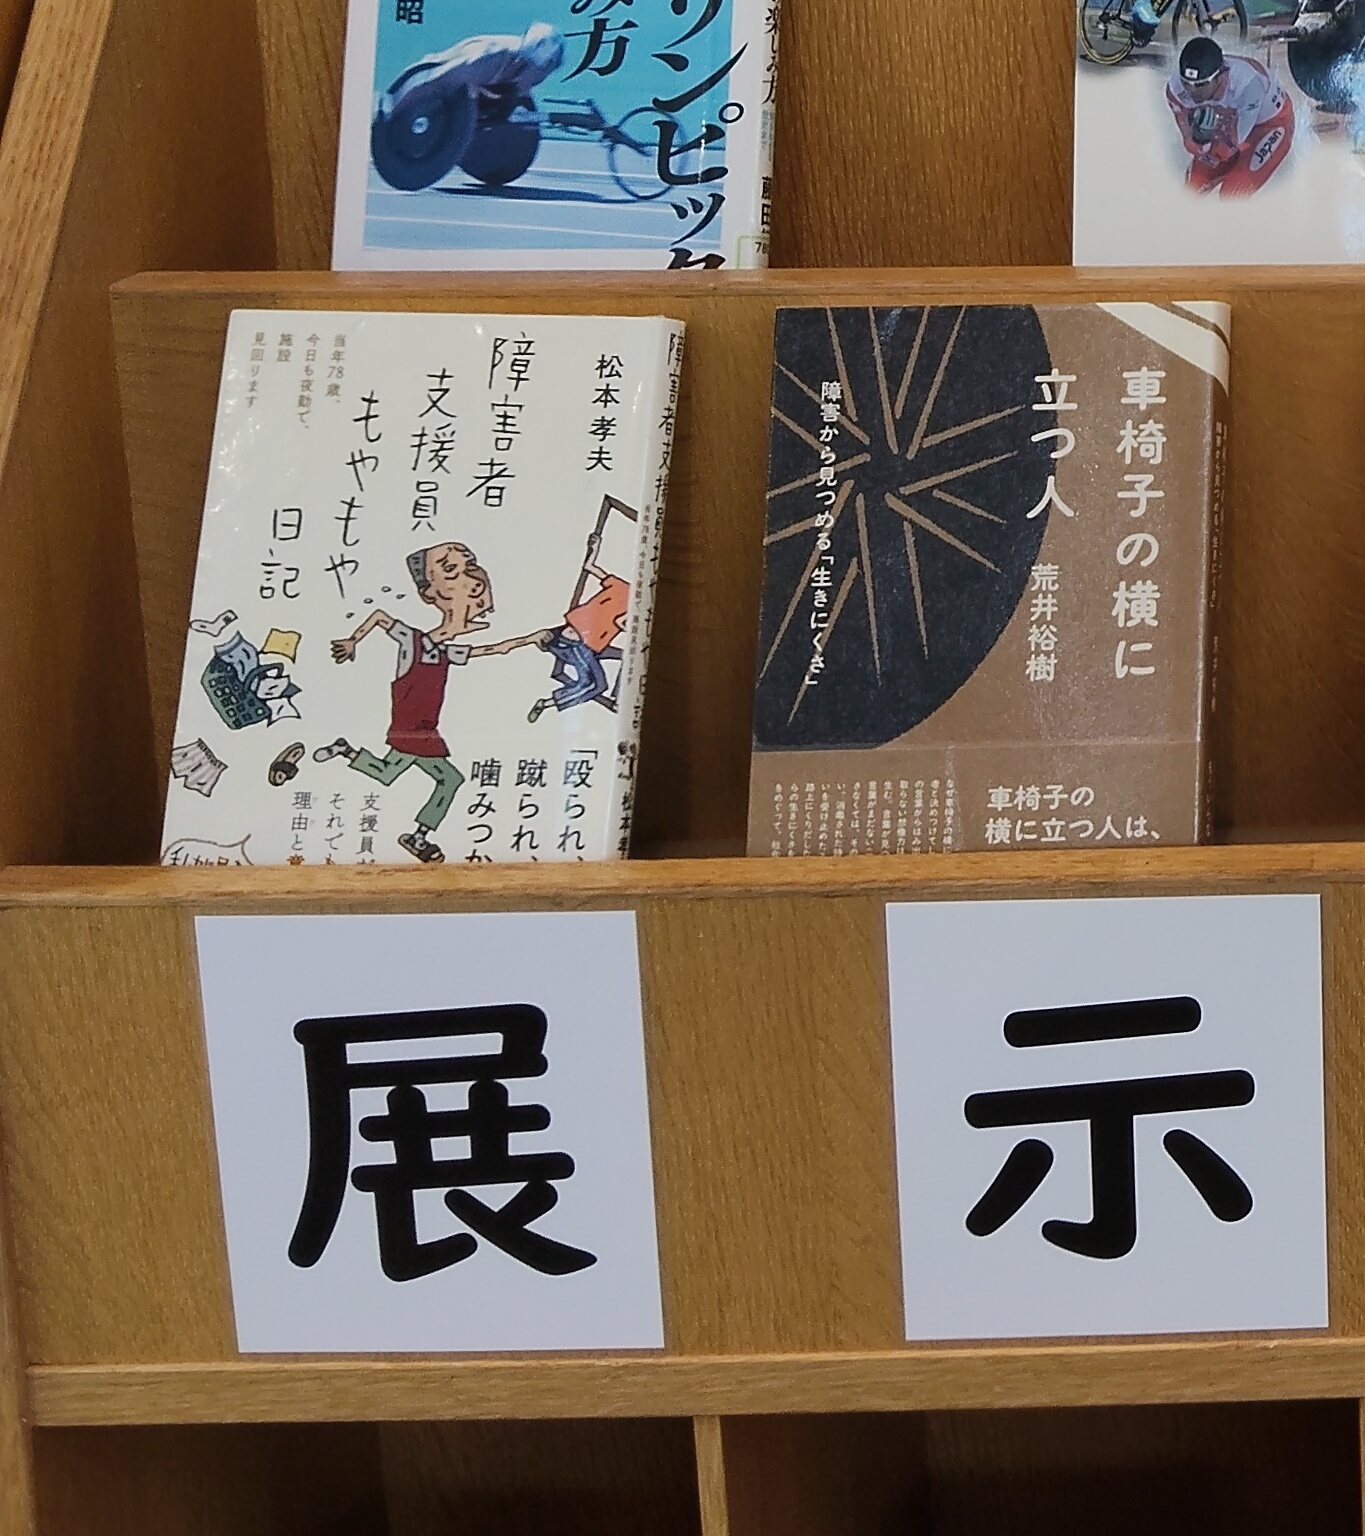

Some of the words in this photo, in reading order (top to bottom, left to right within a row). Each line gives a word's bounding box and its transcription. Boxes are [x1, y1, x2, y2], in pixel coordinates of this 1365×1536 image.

[410, 368, 458, 532] 支援員
[465, 331, 536, 508] 障害者
[585, 354, 624, 473] 松本孝夫
[1024, 367, 1079, 521] 立つ人
[259, 507, 303, 600] 日記
[324, 390, 382, 600] もやもや
[1112, 366, 1168, 681] 車椅子の横に
[1025, 563, 1060, 684] 荒井裕樹
[984, 815, 1163, 846] 横に立つ人は、
[985, 785, 1096, 813] 車椅子の
